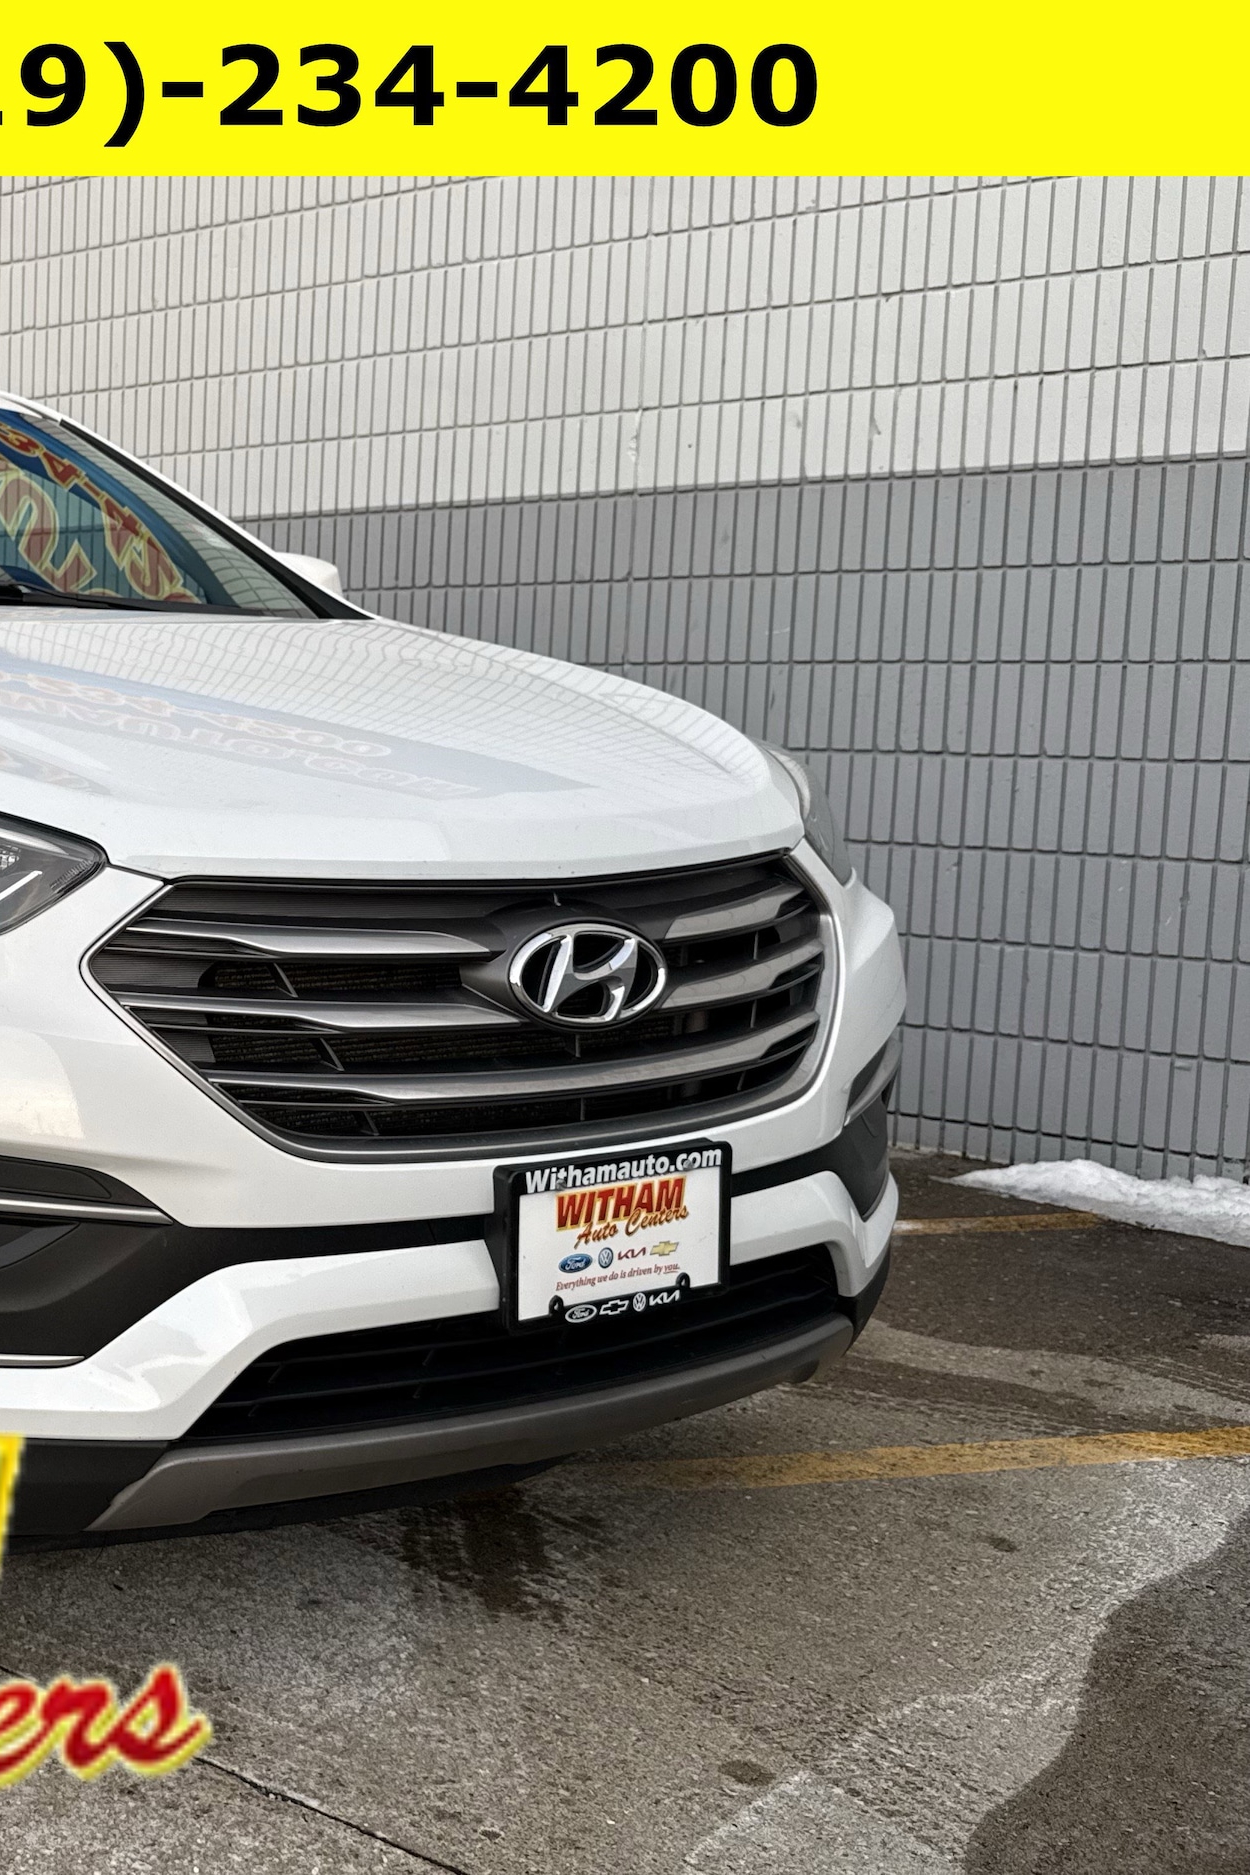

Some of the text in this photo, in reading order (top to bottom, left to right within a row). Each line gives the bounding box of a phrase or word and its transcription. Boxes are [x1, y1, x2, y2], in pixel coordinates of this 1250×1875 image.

[525, 1148, 722, 1194] Withamauto.com
[556, 1176, 686, 1230] WITHAM
[574, 1204, 689, 1249] Auto Centers
[555, 1276, 596, 1291] Everything
[597, 1274, 608, 1282] we
[609, 1271, 619, 1280] do
[620, 1269, 626, 1278] is
[627, 1267, 652, 1278] driven
[654, 1264, 663, 1275] by
